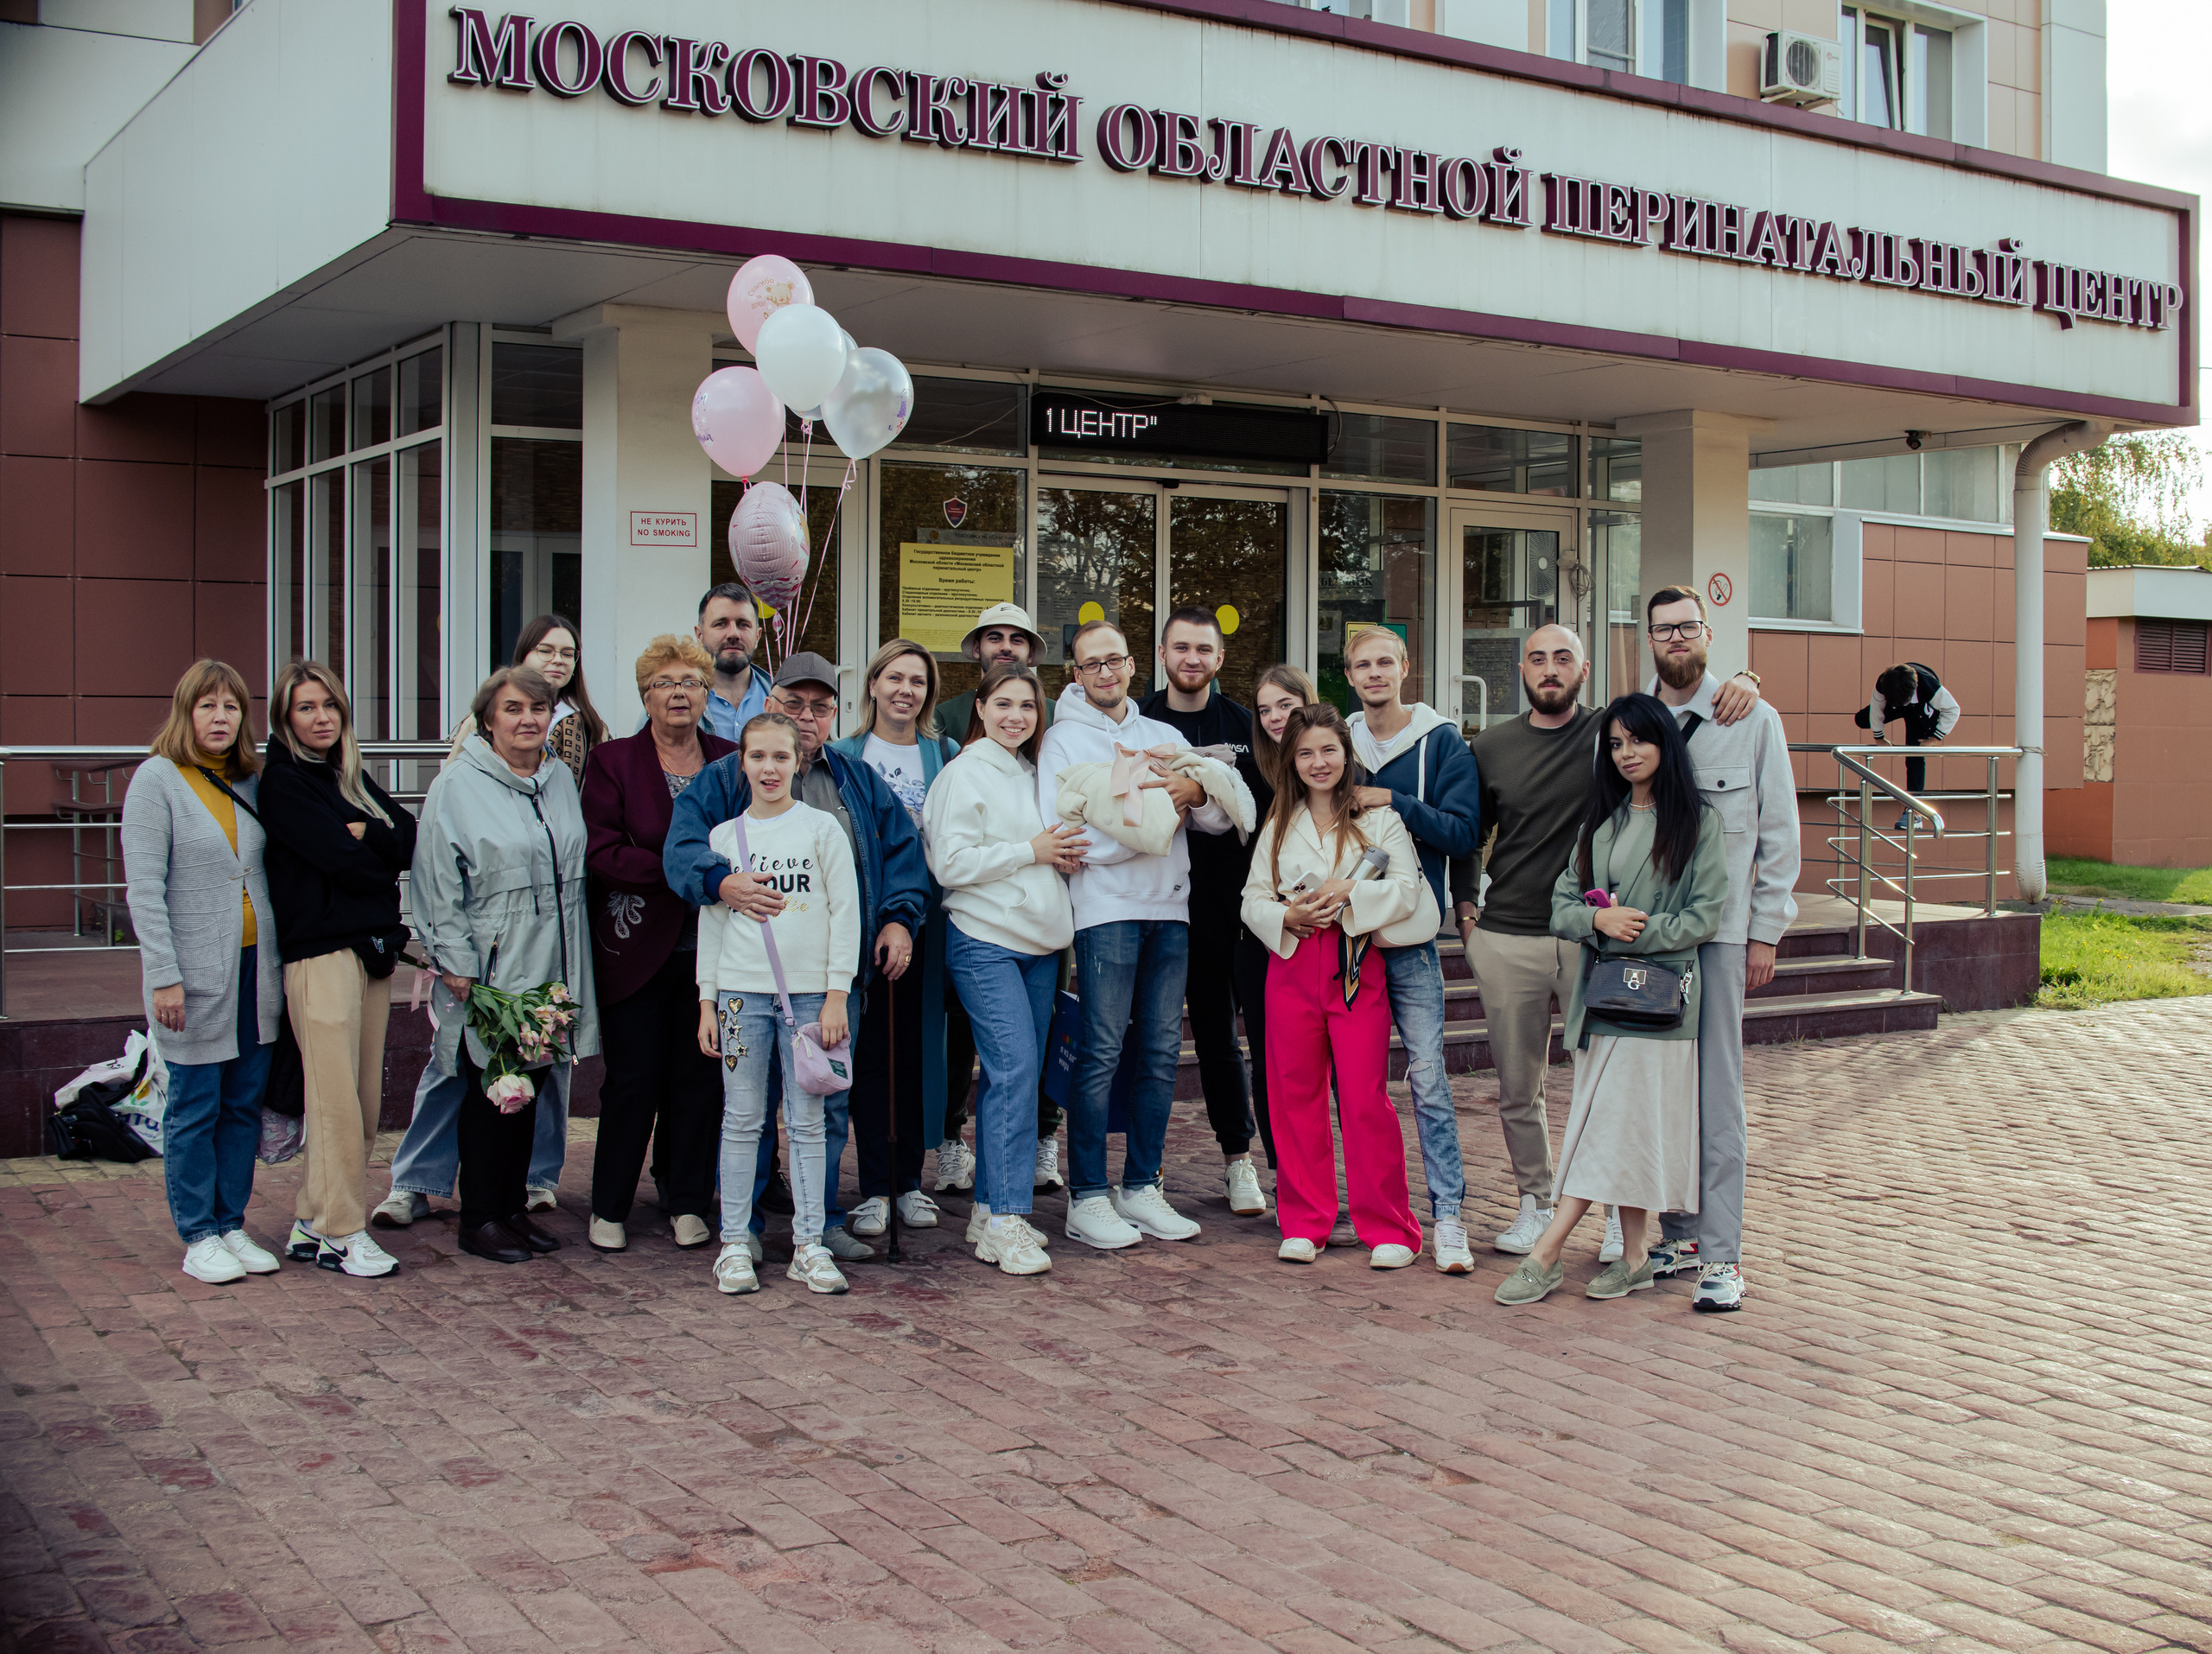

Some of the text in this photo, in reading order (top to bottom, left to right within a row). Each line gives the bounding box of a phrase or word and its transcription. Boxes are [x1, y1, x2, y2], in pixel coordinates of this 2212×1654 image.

[447, 4, 2183, 331] МОСКОВСКИЙ ОБЛАСТНОЙ ПЕРИНАТАЛЬНЫЙ ЦЕНТР
[652, 529, 690, 538] SMOKING
